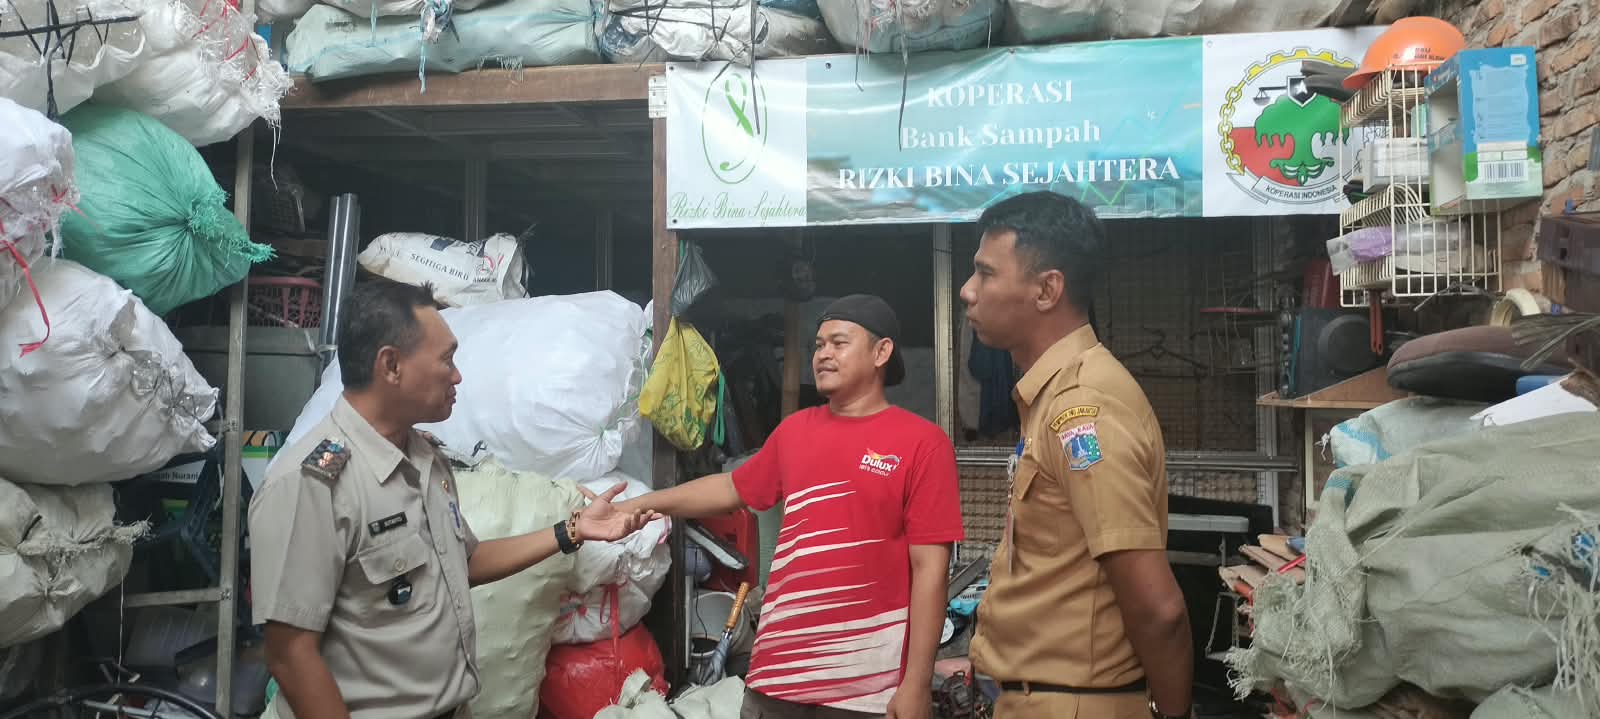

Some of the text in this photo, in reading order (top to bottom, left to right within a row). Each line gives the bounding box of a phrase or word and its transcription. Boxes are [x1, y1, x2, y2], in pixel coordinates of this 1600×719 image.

[928, 79, 1073, 108] KOPERASI
[902, 119, 1101, 149] Bank Sampah
[838, 156, 1182, 190] RIZKI BINA SEJAHTERA
[1265, 184, 1337, 199] KOPERASI INDONESIA
[670, 190, 808, 225] Rizki Bina Sejahtera
[861, 454, 893, 472] Dulux
